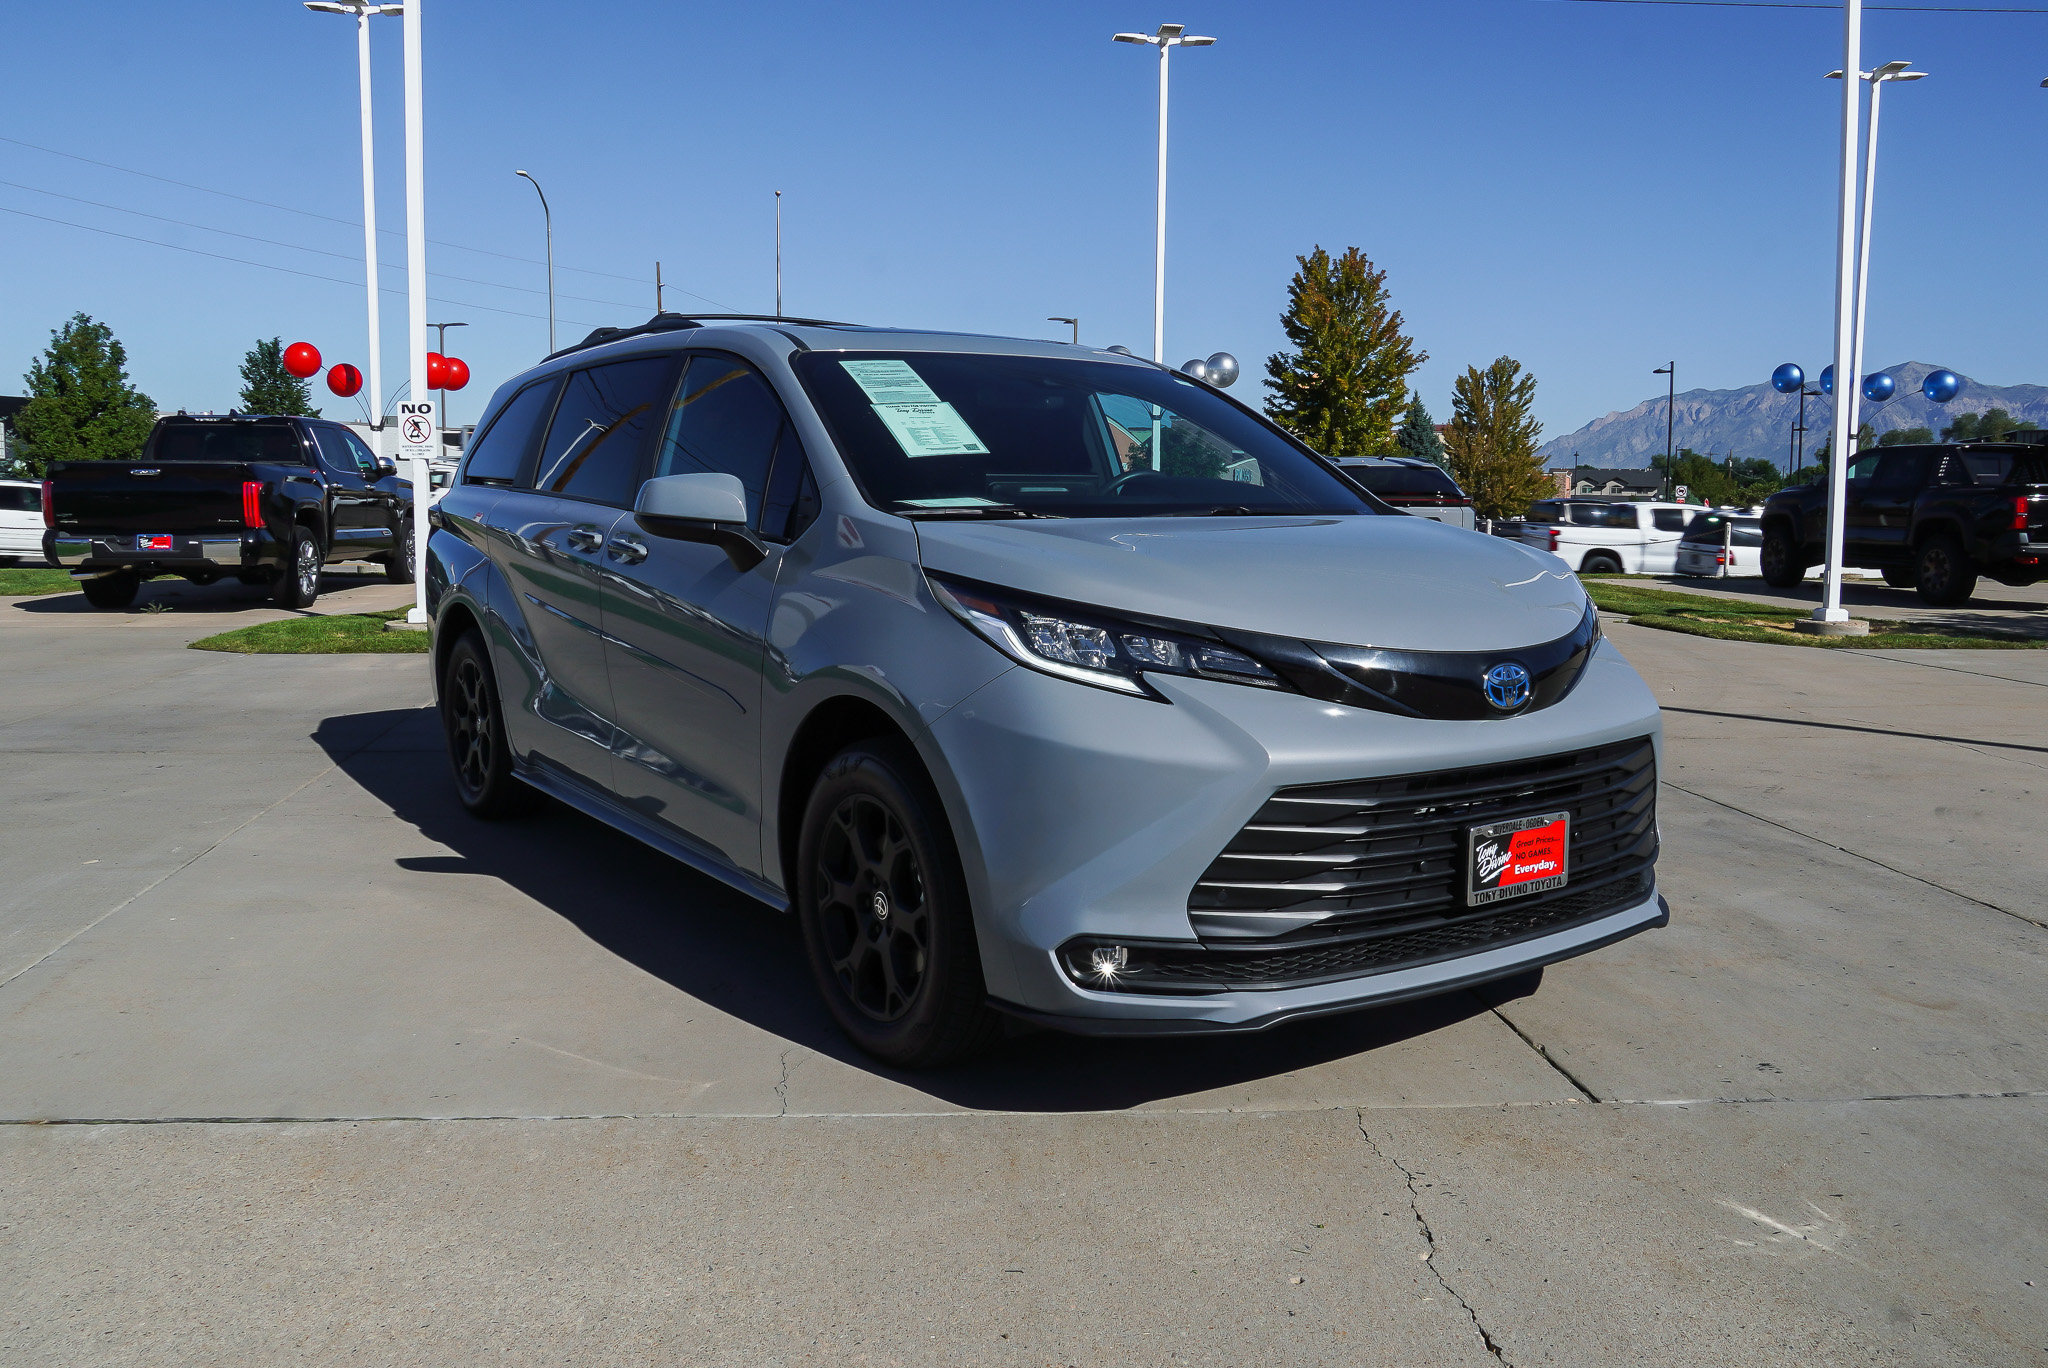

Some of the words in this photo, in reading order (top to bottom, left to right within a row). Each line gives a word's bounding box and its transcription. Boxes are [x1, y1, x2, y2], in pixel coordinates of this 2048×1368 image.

[401, 403, 431, 414] NO
[1526, 817, 1544, 828] OGDEN
[1476, 840, 1498, 862] Tony
[1516, 840, 1534, 849] Great
[1516, 852, 1526, 860] NO
[1528, 847, 1552, 858] GAMES.
[1477, 851, 1512, 877] Divino
[1515, 860, 1557, 874] Everyday.
[1474, 892, 1498, 905] TONY
[1499, 884, 1528, 899] DIVINO
[1531, 876, 1563, 892] TOYOTA
